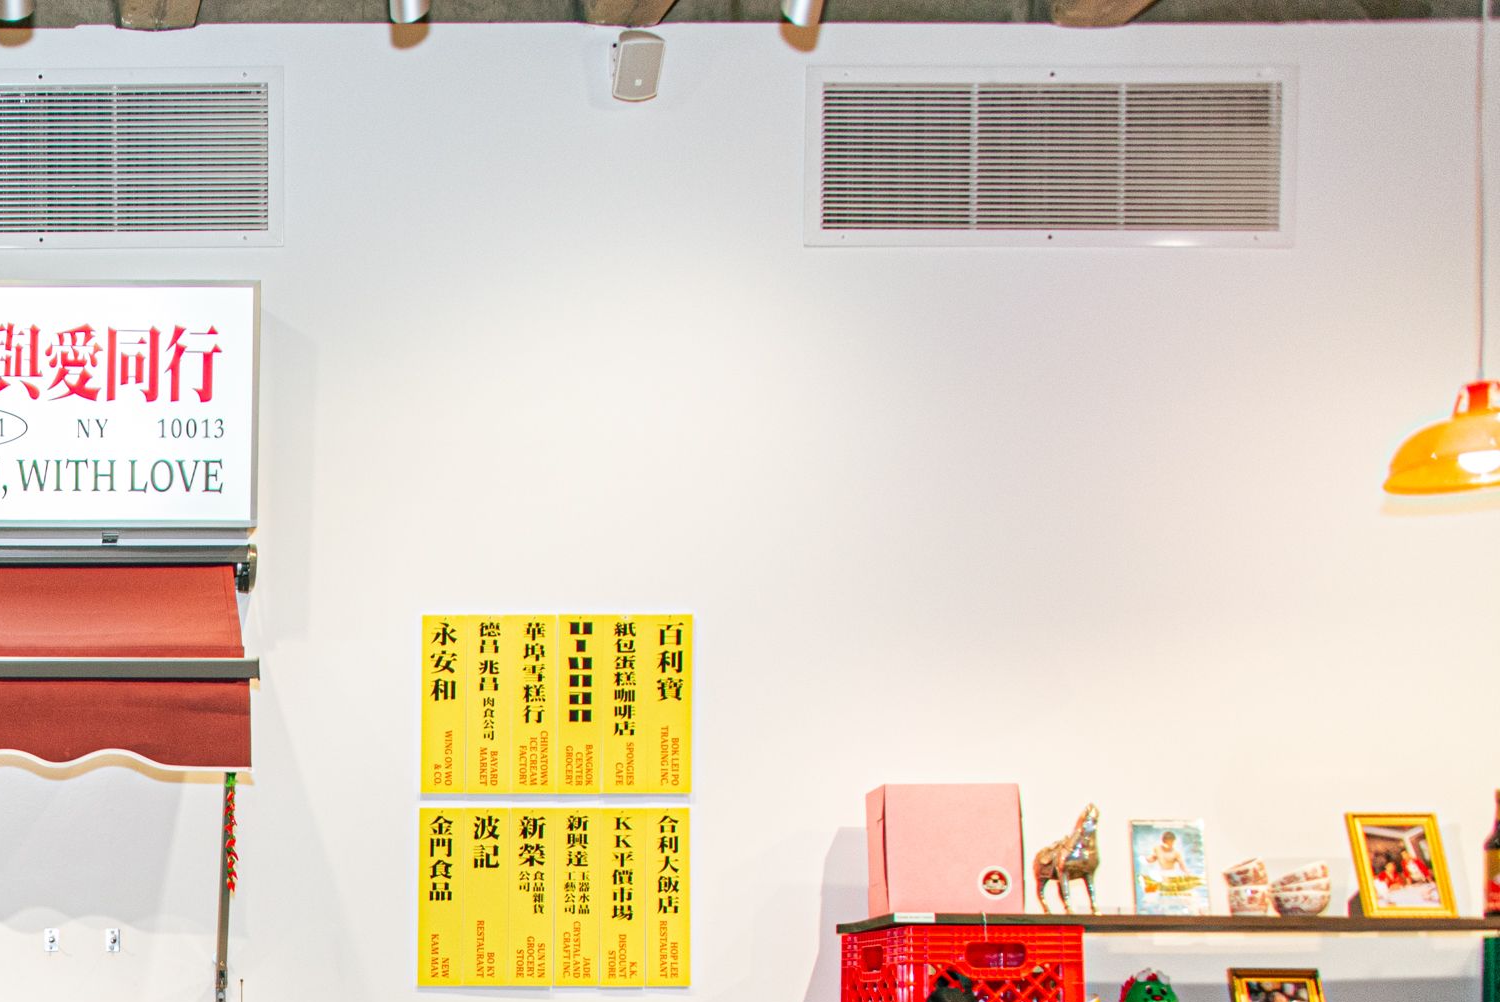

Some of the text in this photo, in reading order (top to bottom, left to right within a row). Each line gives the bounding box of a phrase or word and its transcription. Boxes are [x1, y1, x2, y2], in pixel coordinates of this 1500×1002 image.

[76, 418, 109, 438] NY
[156, 418, 225, 439] 10013
[17, 459, 117, 493] WITH
[128, 459, 224, 494] LOVE
[430, 621, 458, 701] 永安和
[523, 622, 546, 723] 華埠雪糕行
[613, 622, 636, 736] 紙包蛋糕咖啡店
[657, 622, 684, 702] 百利寶
[483, 697, 495, 741] 肉食公司
[444, 730, 453, 786] WING ON WO
[480, 747, 488, 786] MARKET
[519, 745, 527, 786] FACTORY
[530, 737, 538, 786] ICE CREAM
[540, 731, 548, 786] CHINATOWN
[566, 745, 574, 786] GROCERY
[585, 744, 593, 786] BANGKOK
[626, 742, 634, 786] SPONGIES
[661, 725, 669, 765] TRADING
[671, 737, 680, 786] BOK LEI PO
[490, 751, 498, 786] BAYARD
[575, 751, 583, 786] CENTER
[615, 762, 624, 786] CAFE
[429, 815, 454, 902] 金門食品
[473, 816, 500, 869] 波記
[519, 816, 546, 867] 新榮
[566, 815, 589, 867] 新興達
[519, 871, 531, 892] 公司
[657, 815, 680, 914] 合利大飯店
[533, 870, 545, 915] 食品雜貨
[430, 933, 439, 978] KAM MAN
[441, 957, 449, 978] NEW
[476, 920, 485, 978] RESTAURANT
[487, 952, 495, 978] BO KY
[516, 949, 524, 978] STORE
[527, 936, 535, 978] GROCERY
[537, 942, 546, 978] SUN VIN
[563, 931, 571, 960] CRAFT
[573, 921, 581, 978] CRYSTAL AND
[583, 957, 591, 978] JADE
[608, 950, 616, 978] STORE
[618, 934, 627, 978] DISCOUNT
[659, 920, 668, 978] RESTAURANT
[670, 942, 679, 978] HOP LEE
